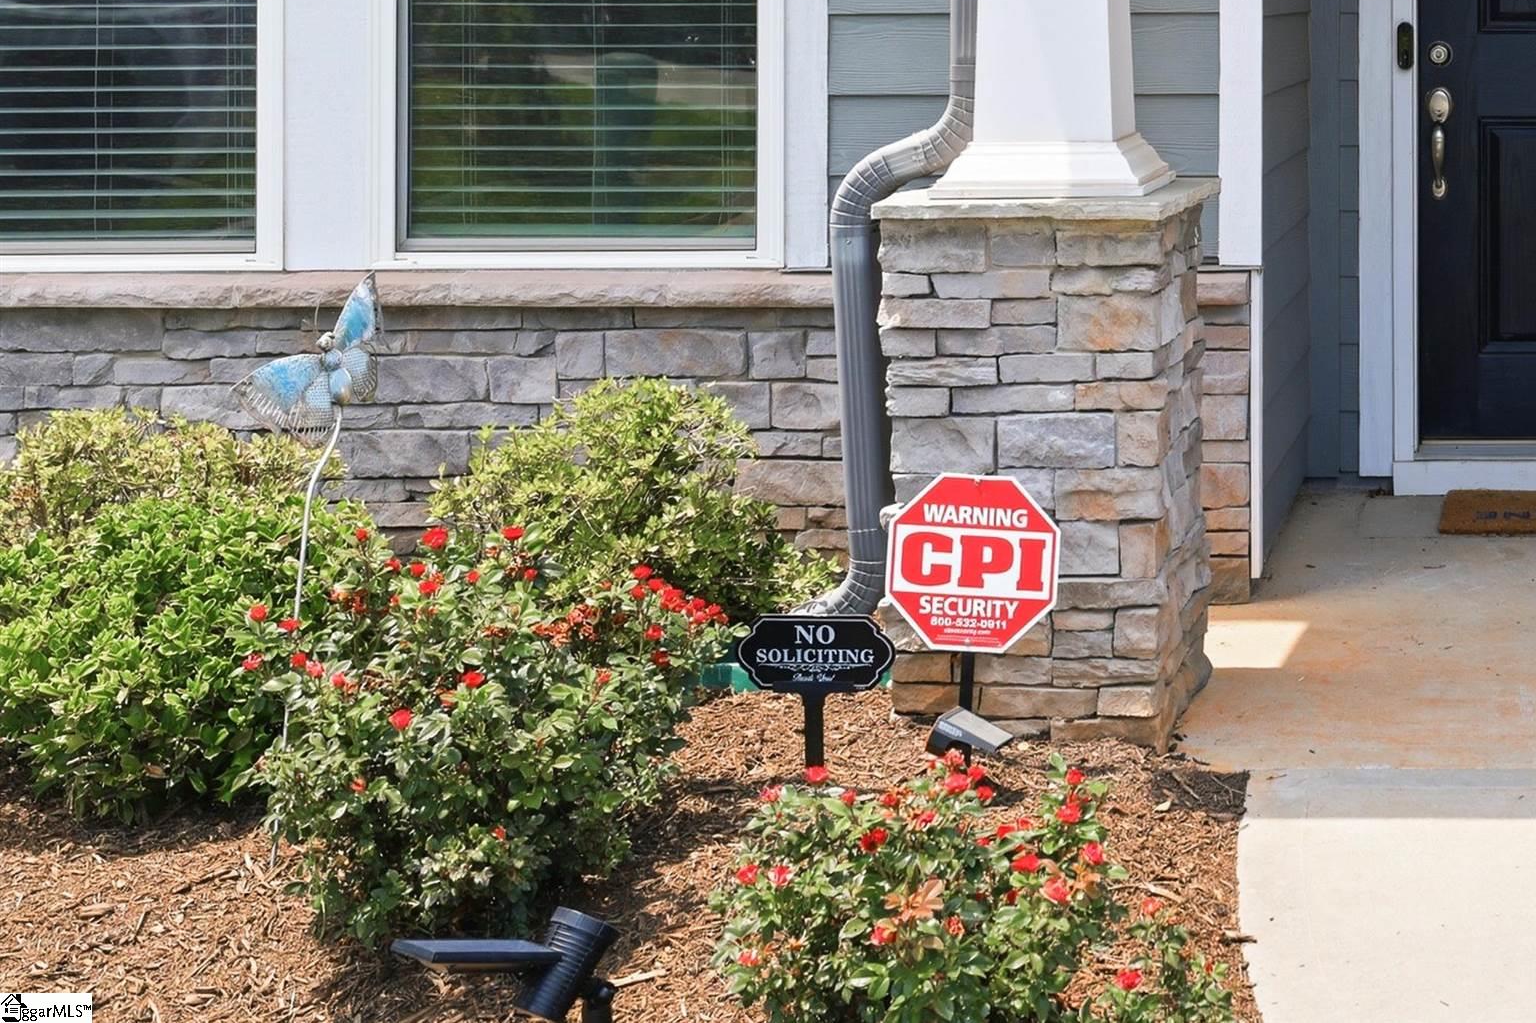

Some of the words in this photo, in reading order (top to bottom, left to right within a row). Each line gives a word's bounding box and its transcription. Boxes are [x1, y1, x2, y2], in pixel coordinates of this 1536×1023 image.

[923, 503, 1028, 528] WARNING
[901, 532, 1046, 592] CPI
[919, 596, 1019, 620] SECURITY
[794, 625, 836, 645] NO
[756, 648, 875, 663] SOLICITING
